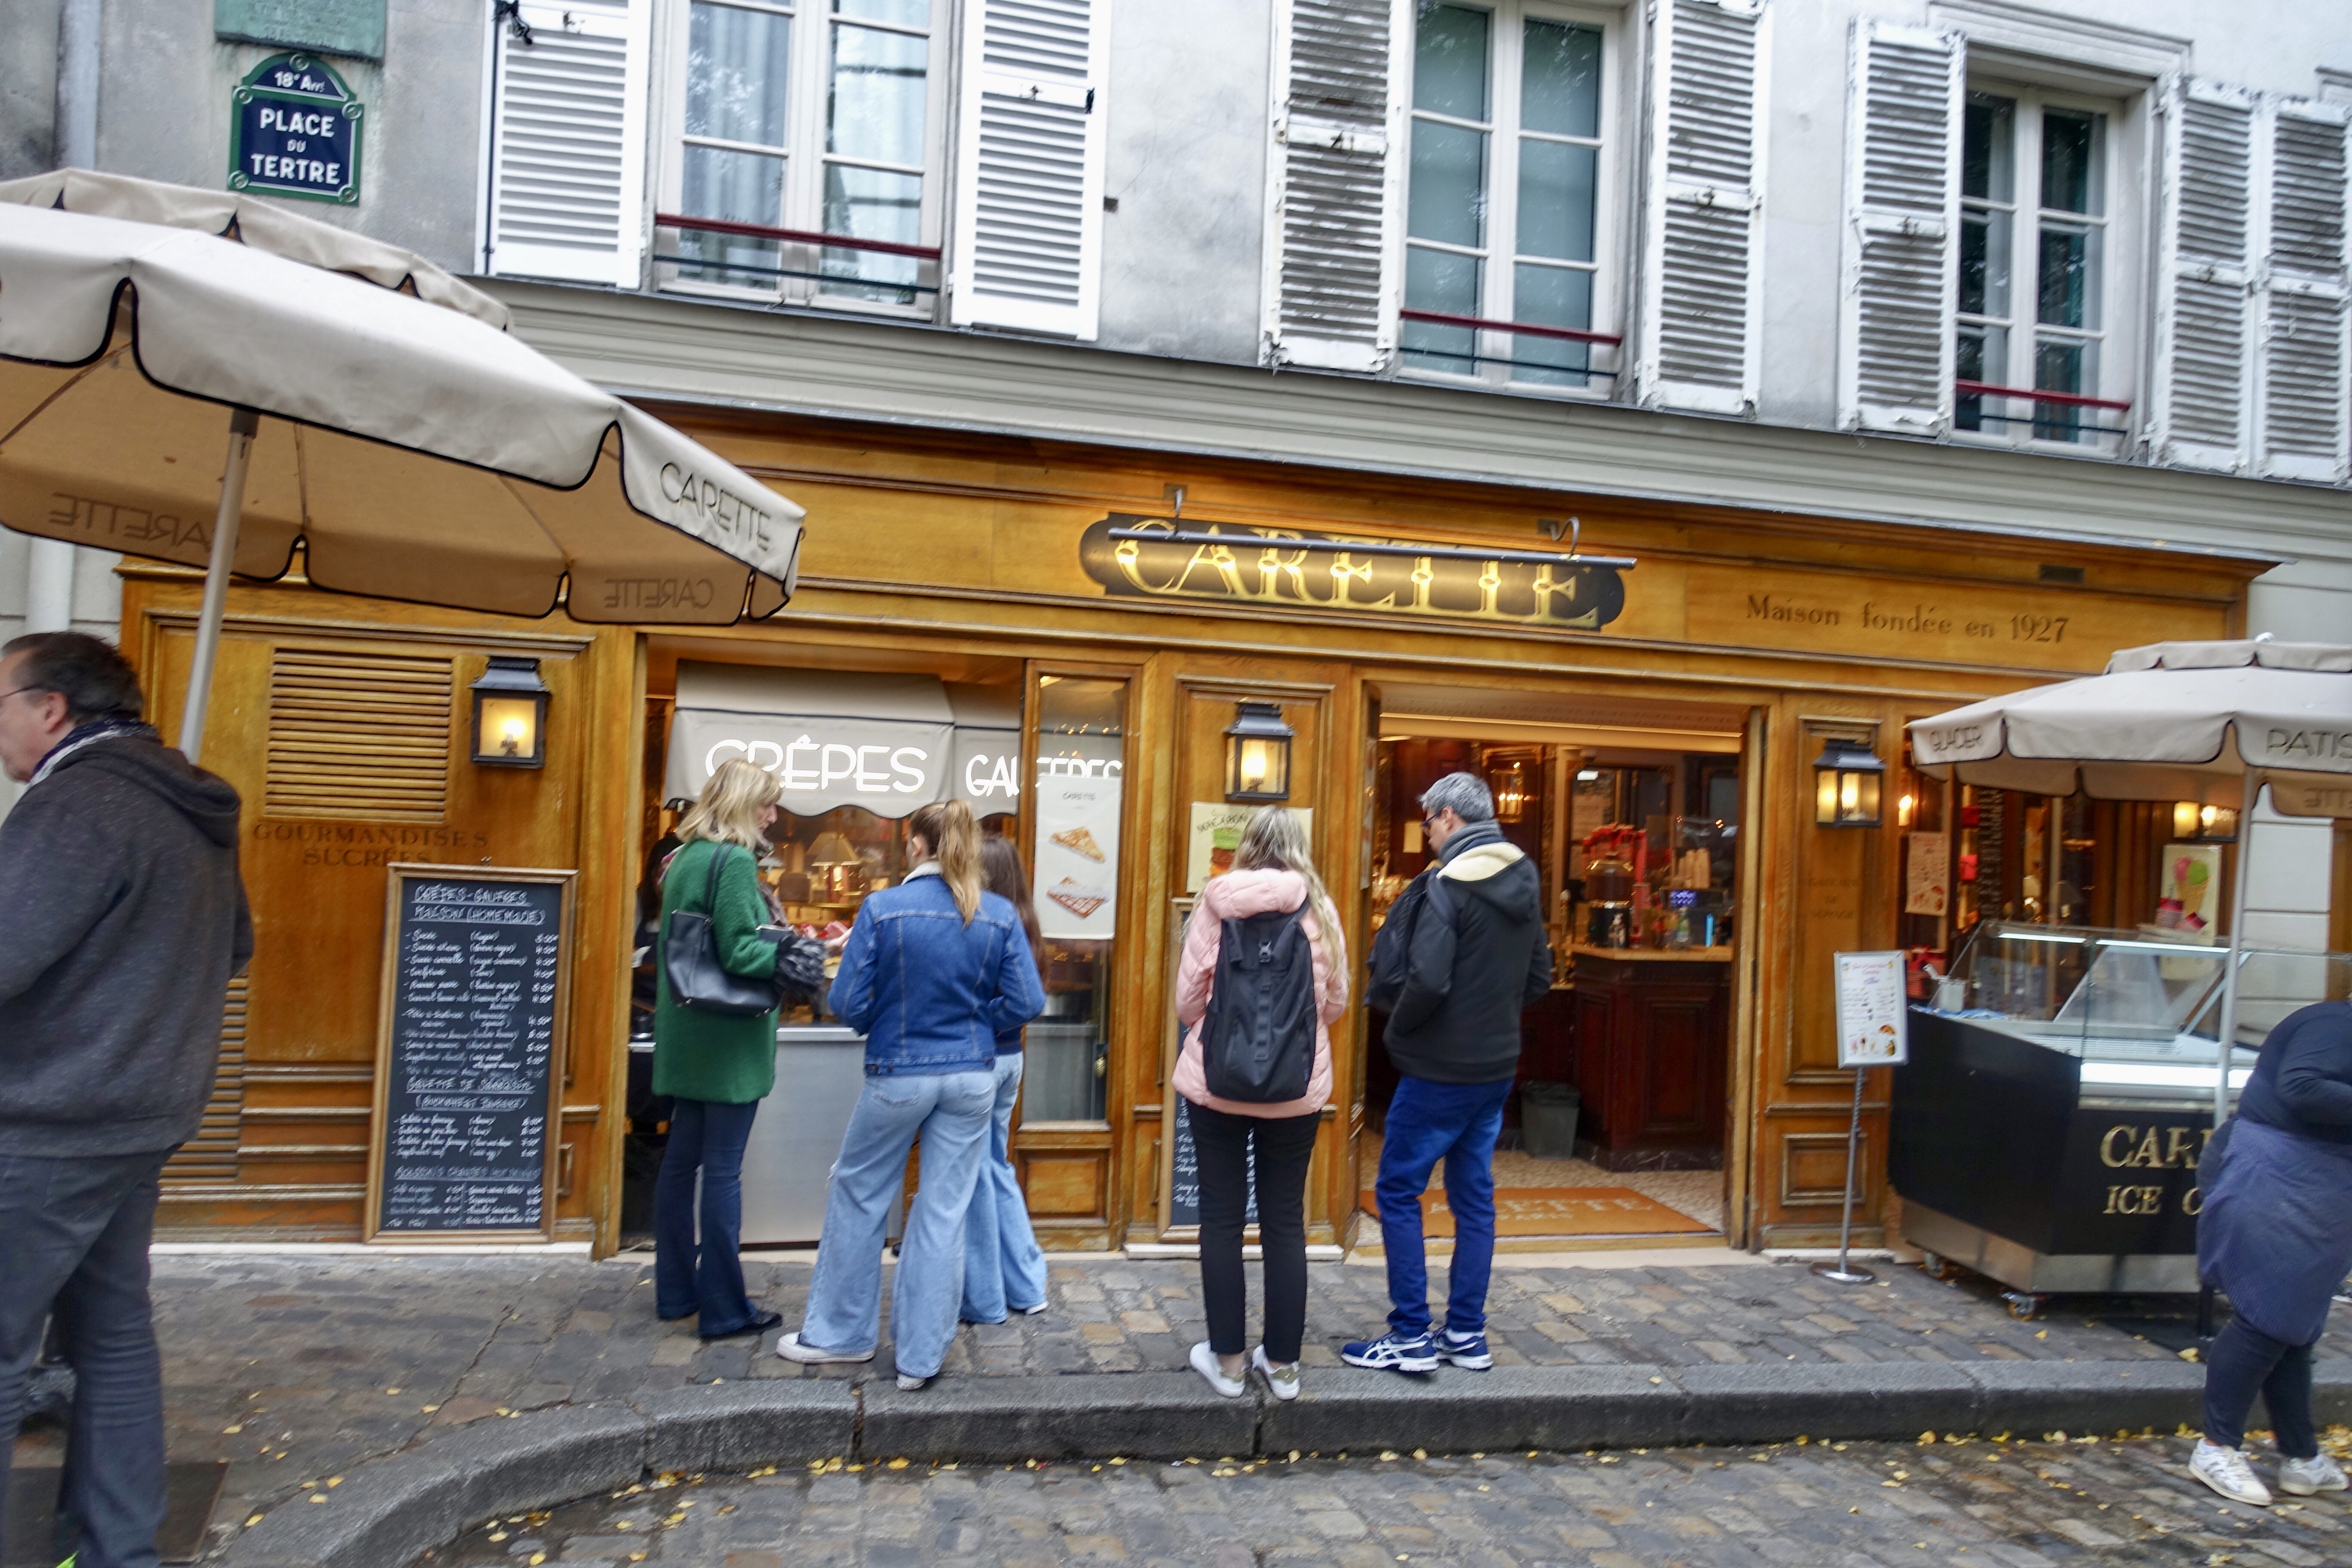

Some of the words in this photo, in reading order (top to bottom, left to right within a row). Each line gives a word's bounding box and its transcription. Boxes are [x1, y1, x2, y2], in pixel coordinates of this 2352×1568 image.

[259, 107, 335, 138] PLACE
[287, 138, 306, 153] DU
[251, 153, 340, 185] TERTRE
[660, 462, 774, 552] CARETTE
[1746, 595, 1840, 626] Maison
[1861, 602, 1952, 635] fondée
[1965, 620, 1995, 639] en
[2010, 615, 2069, 644] 1927
[1062, 791, 1096, 801] CARETTE
[253, 823, 489, 848] GOURMANDISES
[2102, 1185, 2163, 1215] ICE
